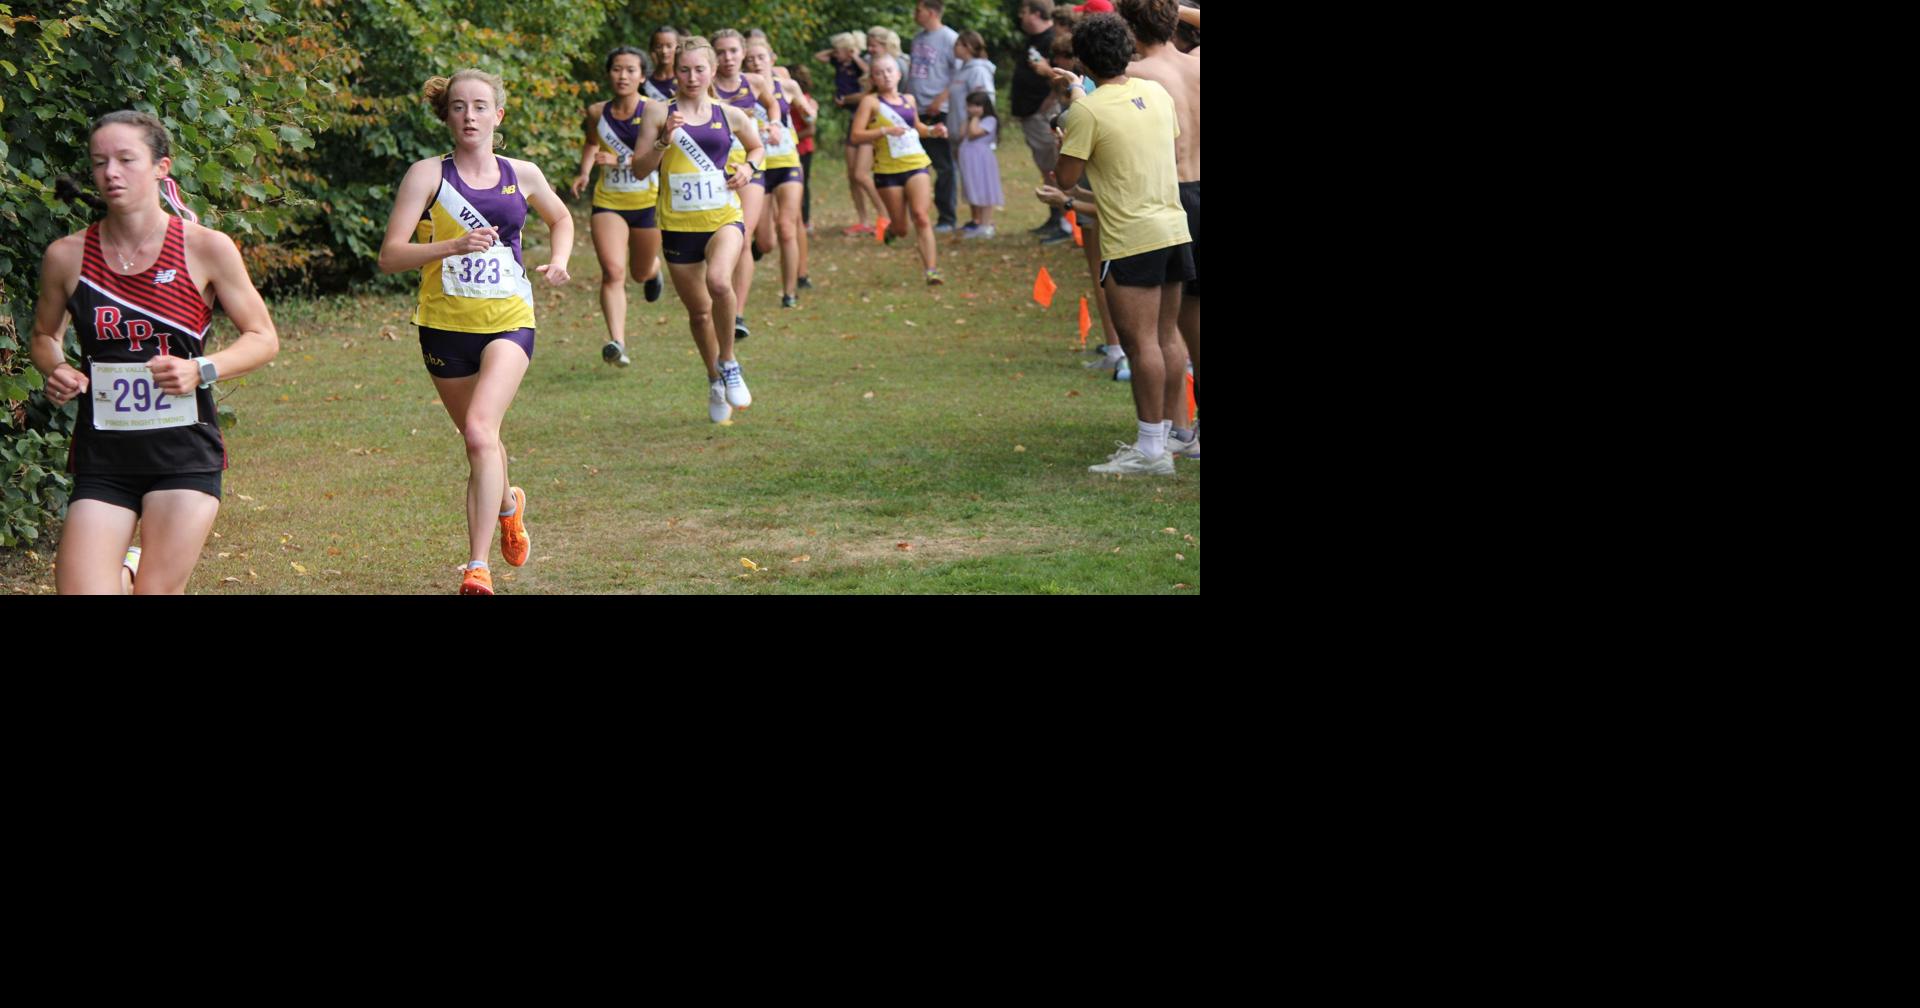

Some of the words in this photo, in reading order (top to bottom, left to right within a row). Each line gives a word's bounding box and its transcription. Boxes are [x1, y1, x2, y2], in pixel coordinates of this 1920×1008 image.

[1131, 97, 1146, 110] W
[502, 184, 516, 195] NB
[682, 181, 713, 201] 311
[154, 269, 177, 284] NB
[459, 257, 500, 284] 323
[94, 306, 173, 356] RPI
[113, 378, 171, 412] 292
